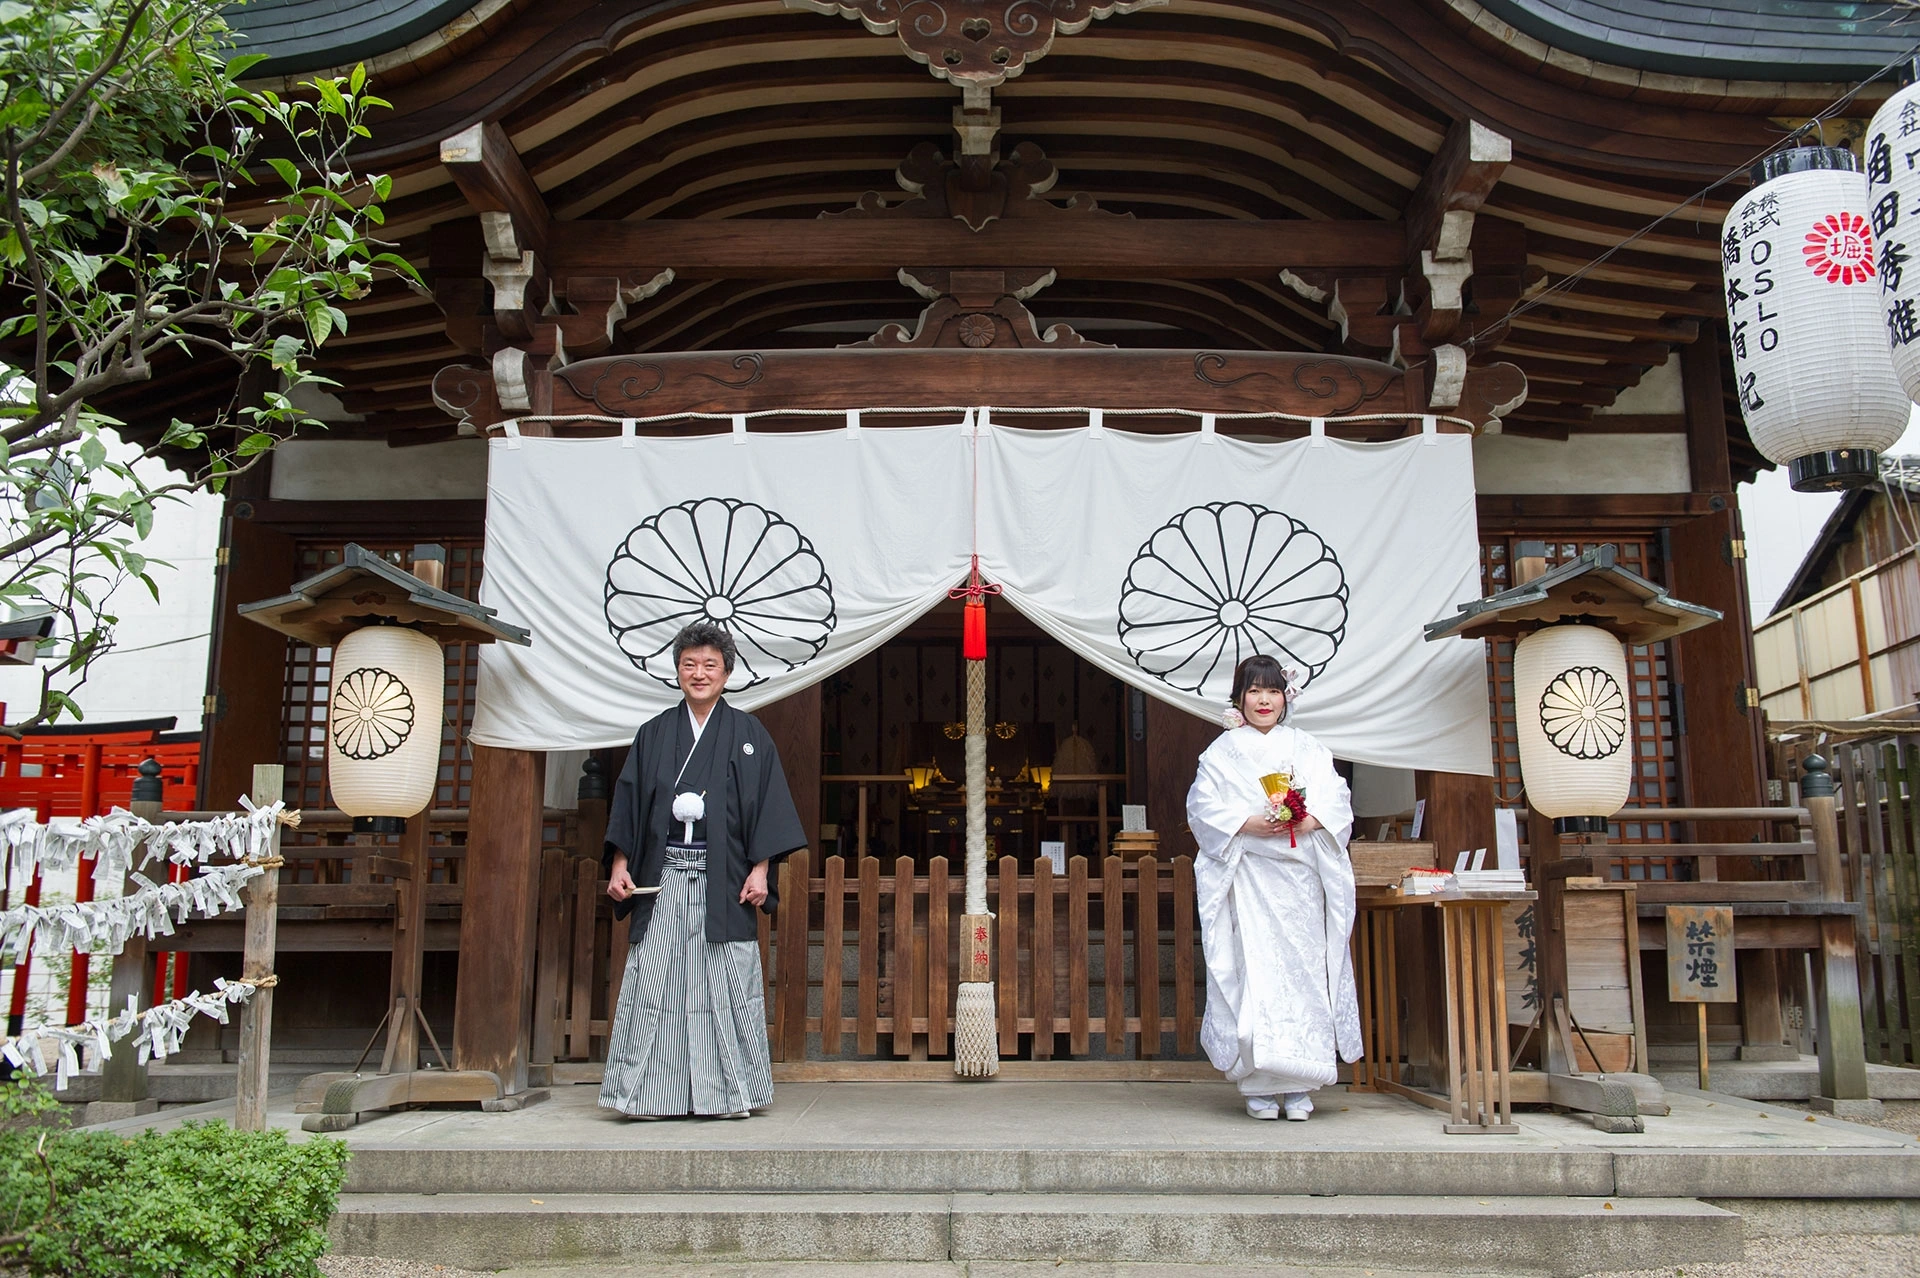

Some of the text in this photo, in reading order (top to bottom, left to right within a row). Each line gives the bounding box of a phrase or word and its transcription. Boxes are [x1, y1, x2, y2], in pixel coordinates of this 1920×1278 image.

[1830, 235, 1861, 259] 堀
[1751, 240, 1779, 351] OSLO
[975, 926, 988, 965] 奉納
[1686, 920, 1718, 987] 禁煙
